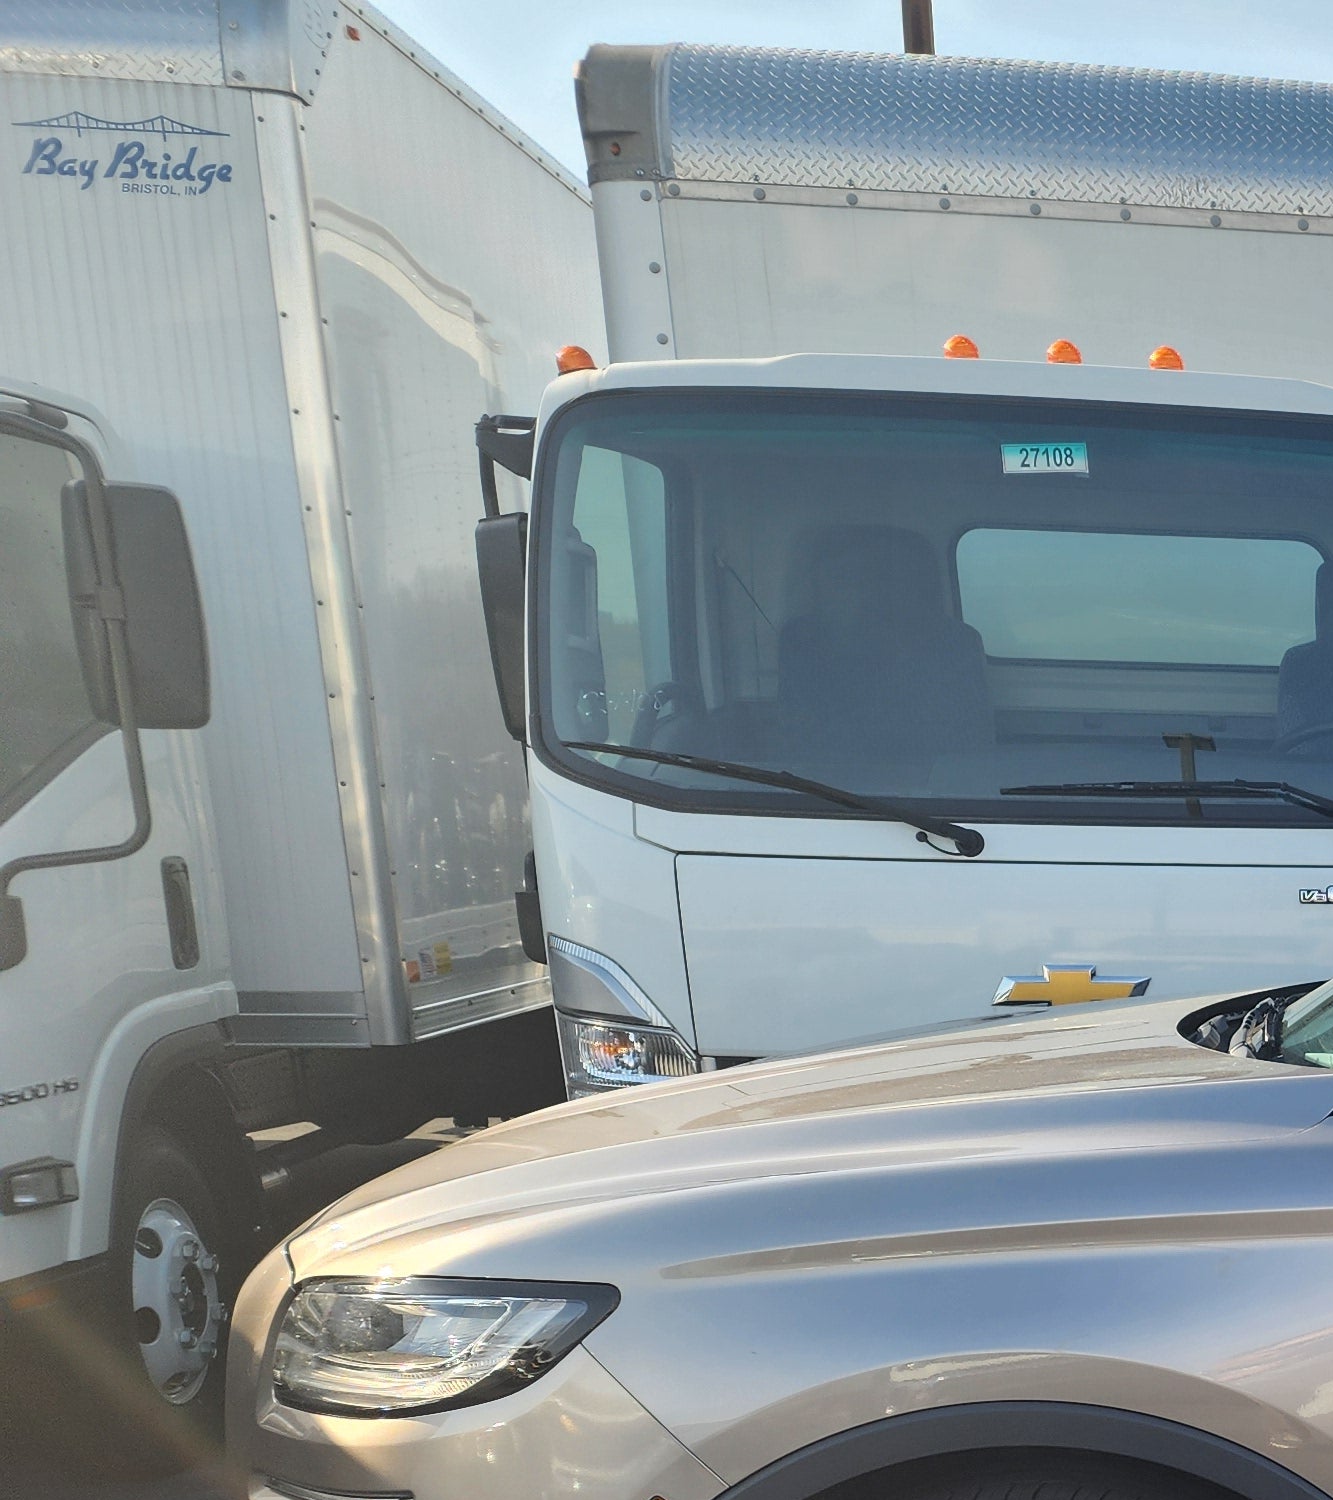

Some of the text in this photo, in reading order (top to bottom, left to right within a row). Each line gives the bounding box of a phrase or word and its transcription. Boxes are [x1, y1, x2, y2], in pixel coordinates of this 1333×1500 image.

[21, 137, 233, 195] Bay Bridge
[121, 182, 198, 197] BRISTOL, IN
[1019, 446, 1075, 468] 27108
